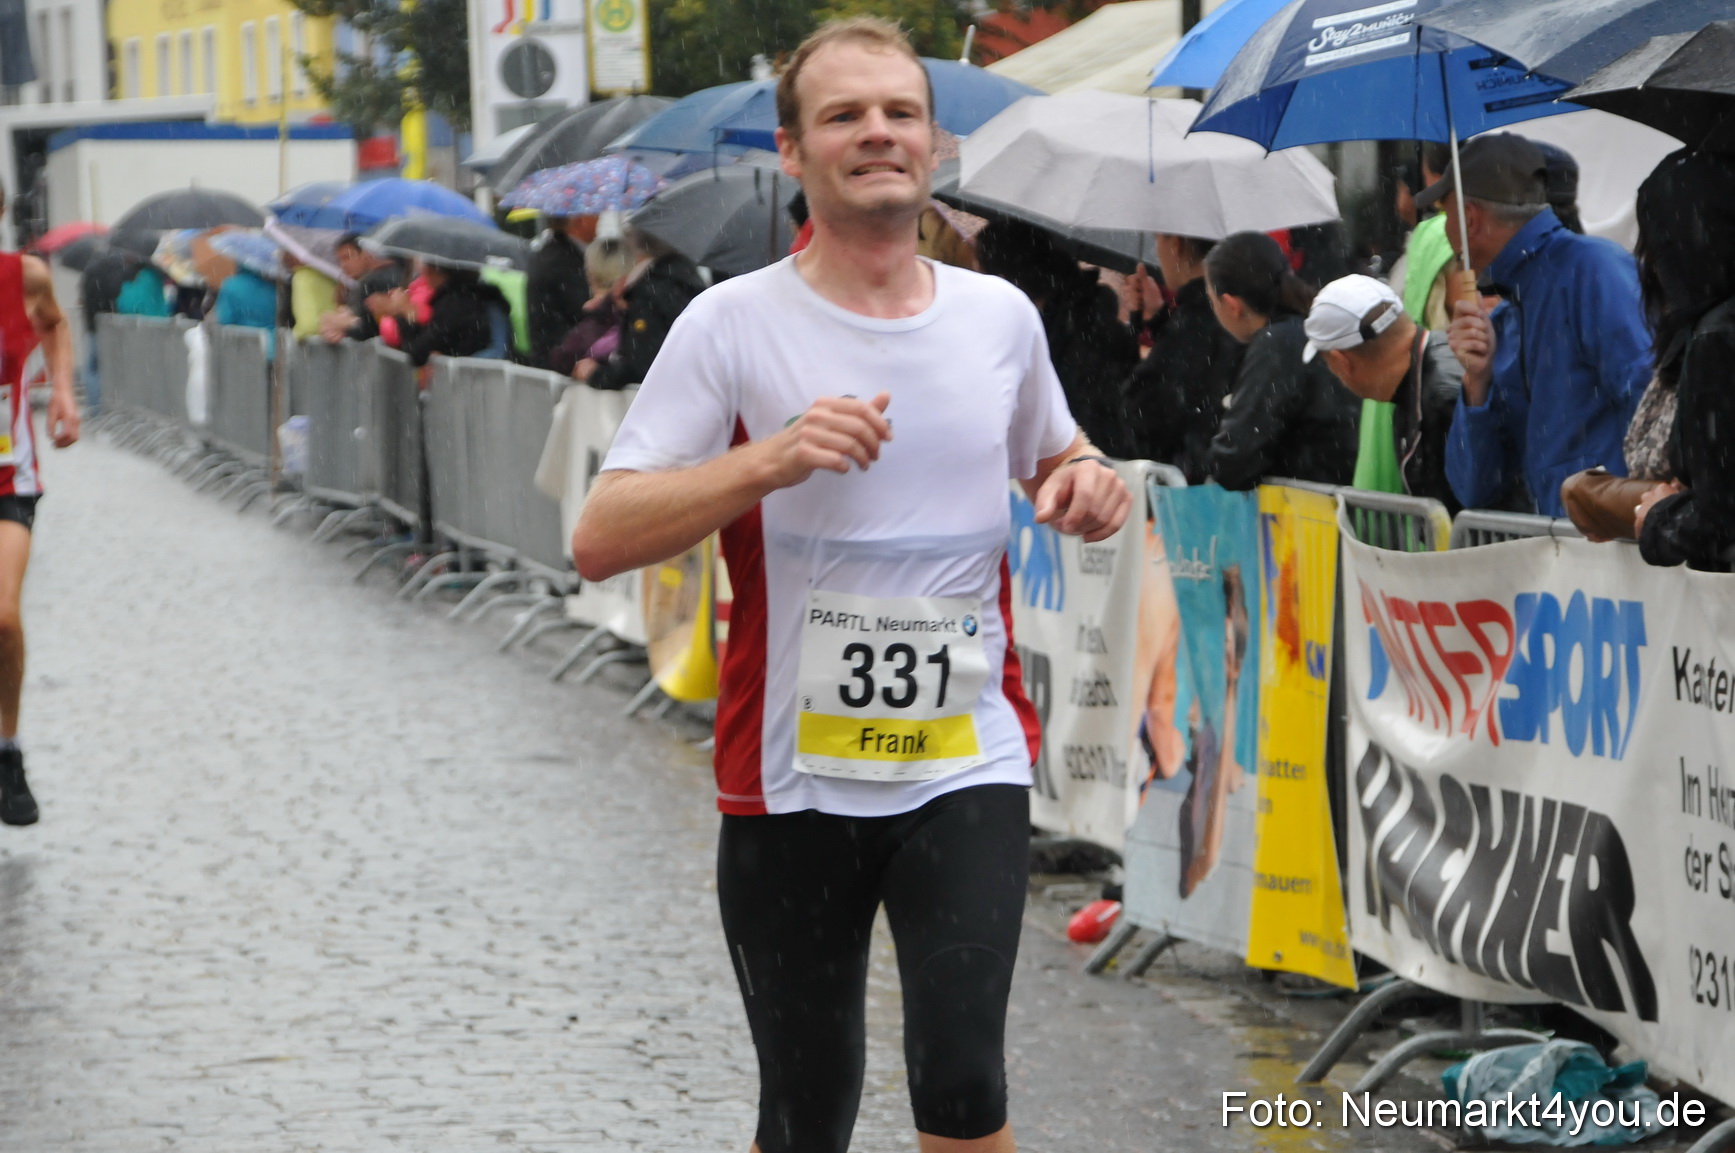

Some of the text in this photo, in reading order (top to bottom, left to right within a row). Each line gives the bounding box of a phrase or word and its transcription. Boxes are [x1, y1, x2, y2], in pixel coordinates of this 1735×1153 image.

[809, 609, 958, 634] PARTL Neumarkt
[839, 642, 950, 709] 331
[860, 727, 929, 755] Frank
